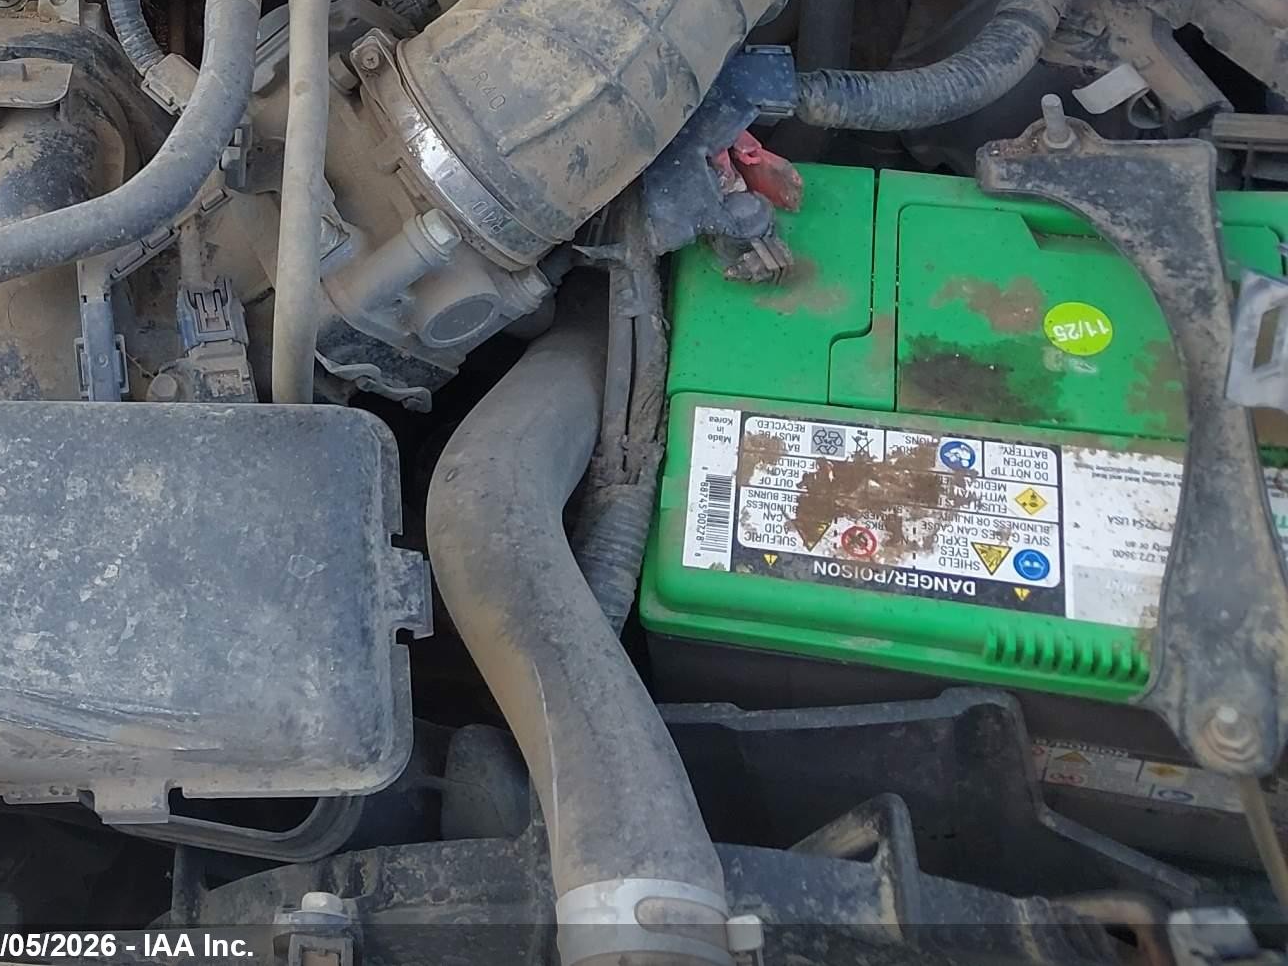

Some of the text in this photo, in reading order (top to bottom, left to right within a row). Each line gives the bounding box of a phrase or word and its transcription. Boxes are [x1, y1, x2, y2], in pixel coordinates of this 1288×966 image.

[1052, 318, 1109, 341] 11/25
[709, 415, 733, 426] Korea
[754, 419, 806, 432] RECYCLED.
[716, 425, 724, 433] in
[707, 434, 732, 444] Made
[1000, 445, 1048, 458] BATTERY.
[777, 457, 807, 468] CHILD
[1003, 456, 1048, 469] OR OPEN
[990, 466, 1049, 481] DO NOT TIP
[758, 477, 794, 488] OUT OF
[964, 479, 1007, 492] MEDICA
[745, 489, 779, 501] BURNS.
[980, 491, 1007, 503] WITH
[972, 500, 1007, 514] FLUSH
[763, 512, 783, 522] CAN
[976, 517, 991, 527] OR
[1107, 515, 1130, 526] USA
[764, 522, 789, 534] ACID
[921, 521, 954, 532] CAUSE
[956, 526, 978, 537] CAN
[993, 519, 1050, 534] BLINDNESS
[743, 532, 797, 546] SULFURIC
[1023, 534, 1050, 546] SIVE
[937, 545, 970, 558] EYES.
[938, 557, 980, 571] SHIELD
[813, 560, 976, 597] DANGER/POISON
